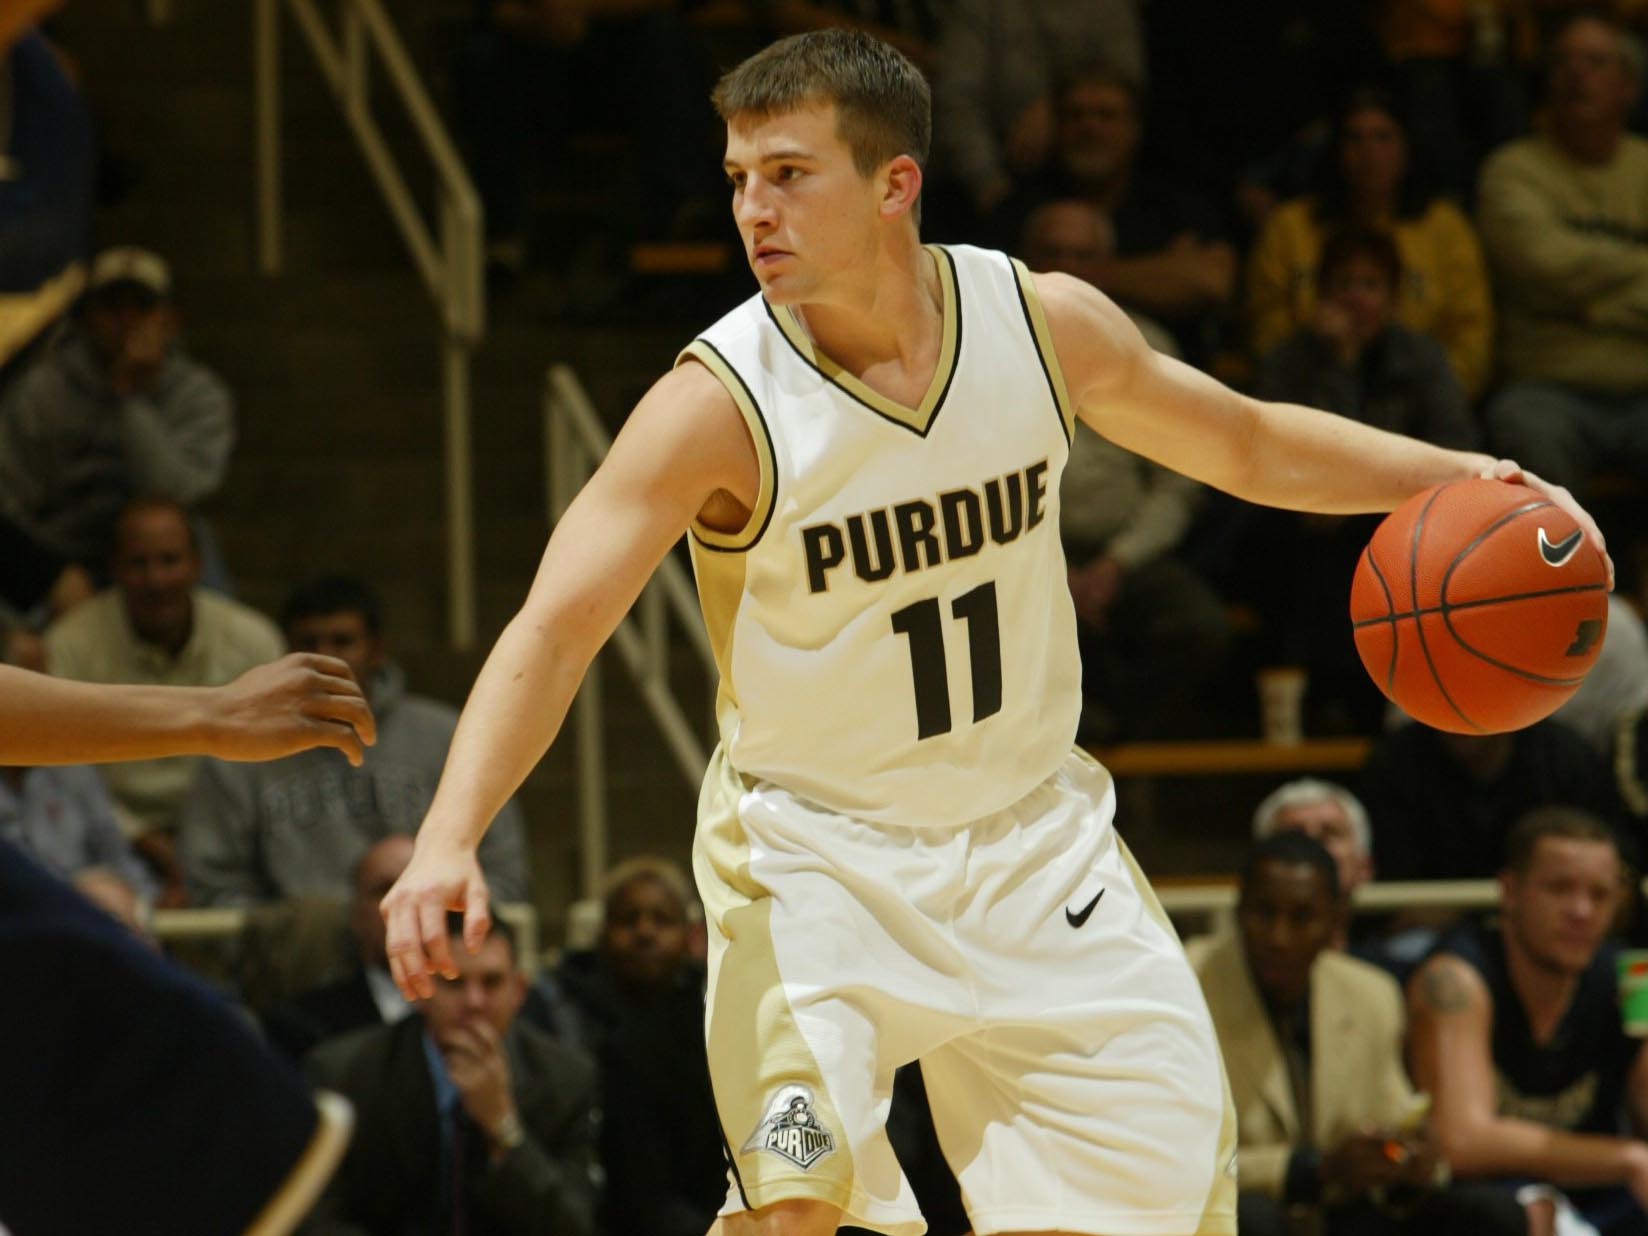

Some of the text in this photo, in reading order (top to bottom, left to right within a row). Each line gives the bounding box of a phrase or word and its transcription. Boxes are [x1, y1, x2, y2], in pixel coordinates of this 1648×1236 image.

[802, 458, 1049, 594] PURDUE
[890, 580, 1003, 741] 11
[766, 1127, 831, 1161] PURDUE
